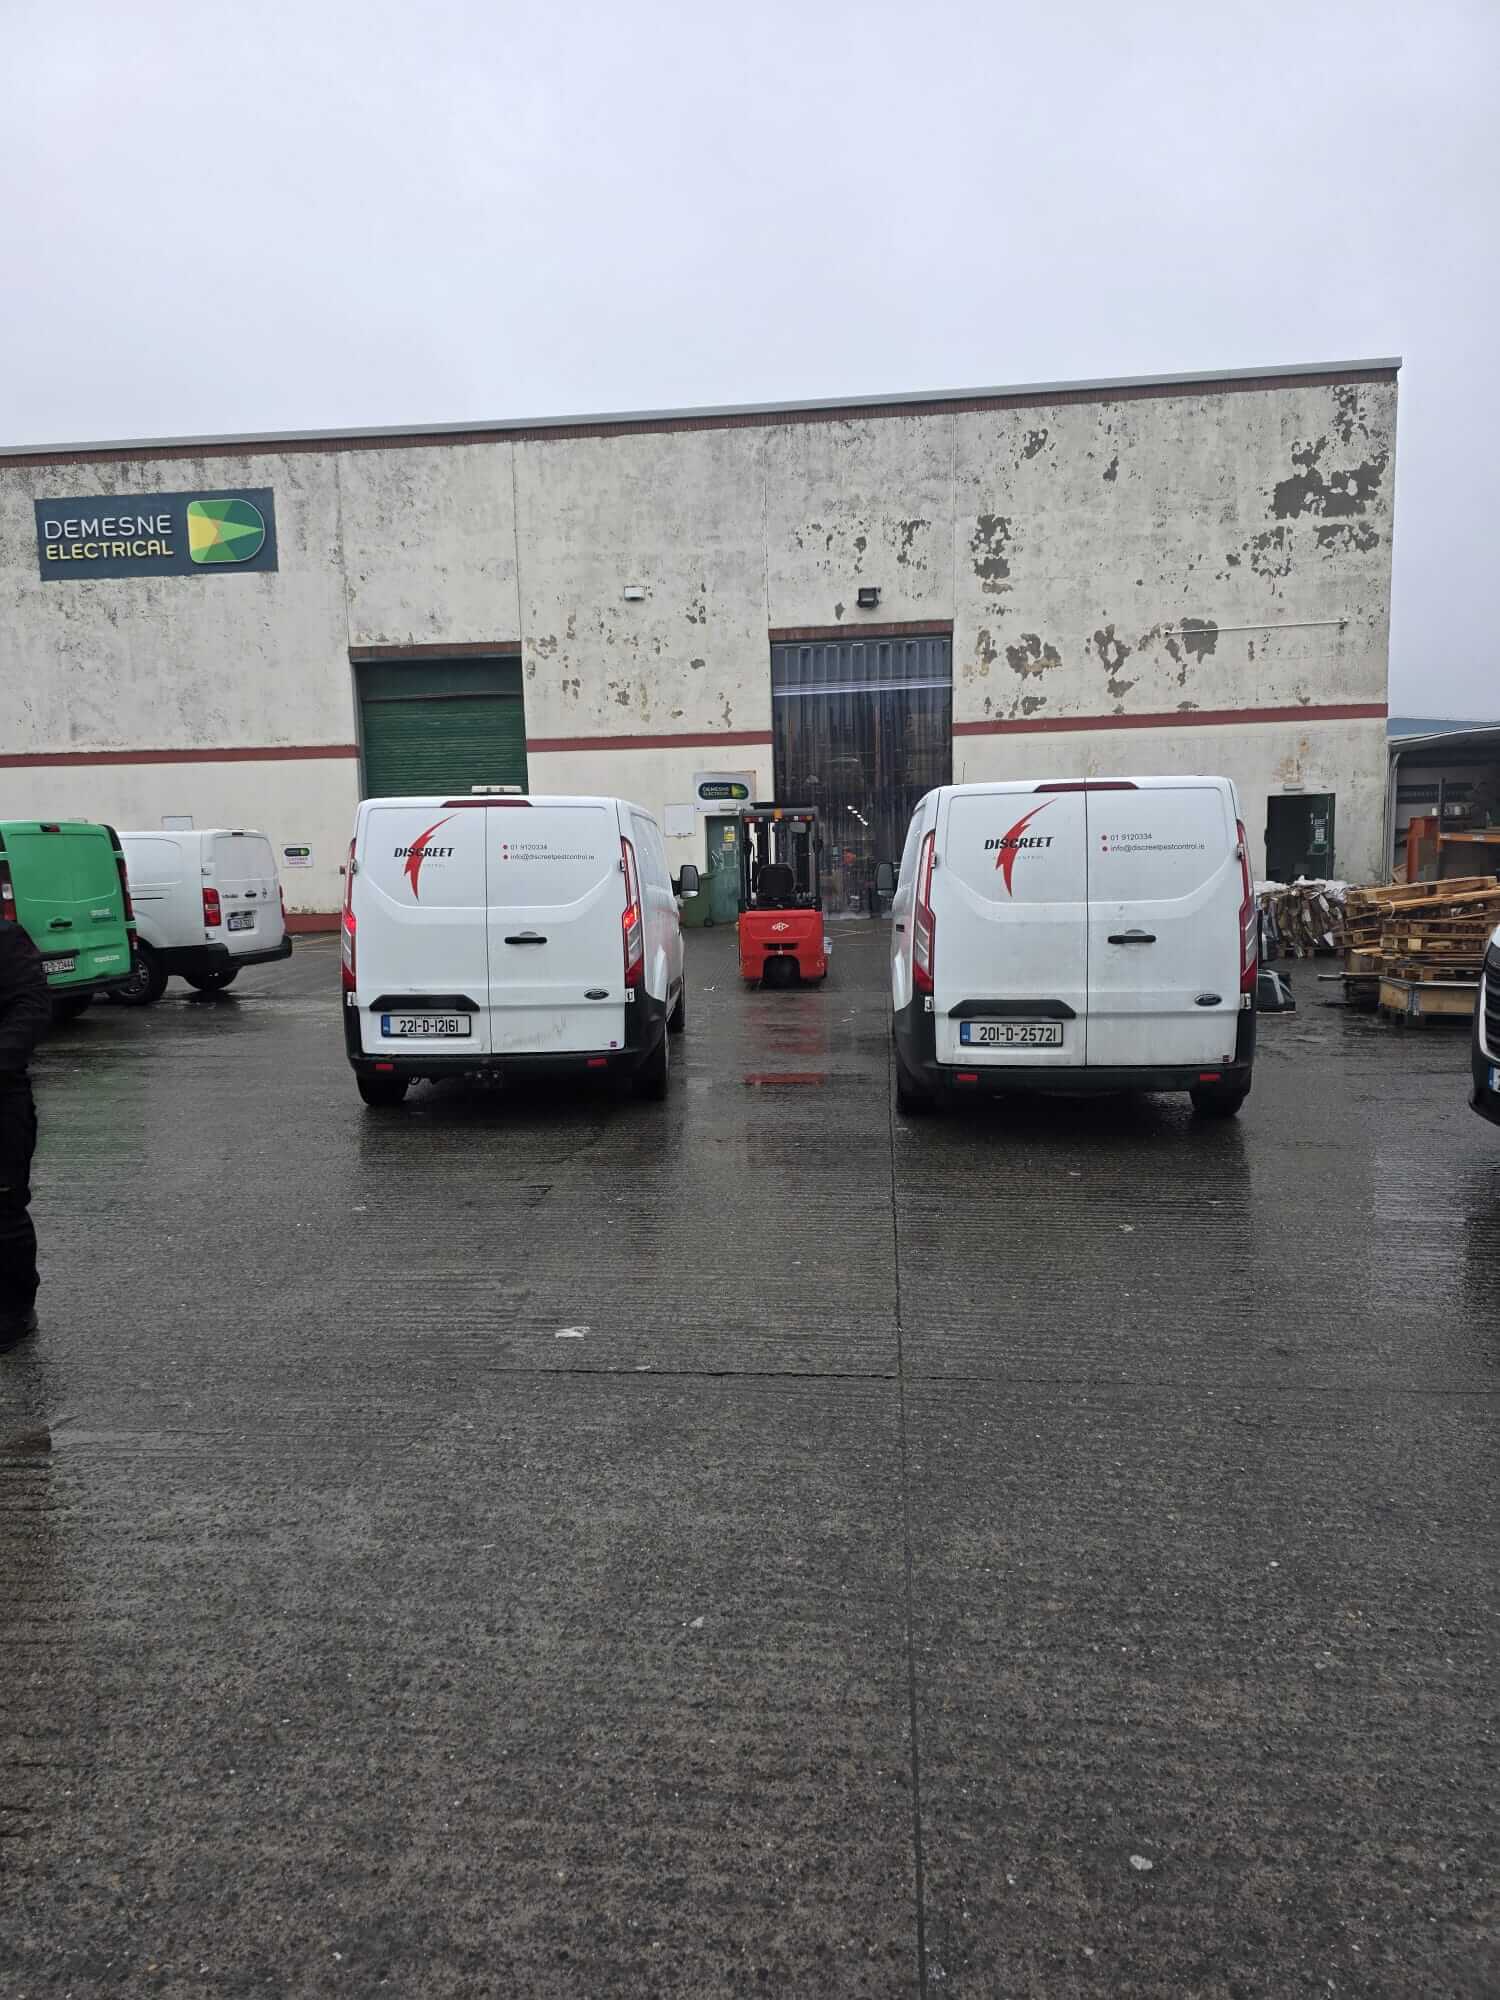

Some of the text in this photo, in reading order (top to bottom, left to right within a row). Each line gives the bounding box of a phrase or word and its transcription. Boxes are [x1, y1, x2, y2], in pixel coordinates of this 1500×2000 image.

[44, 514, 173, 539] DEMESNE
[46, 540, 174, 560] ELECTRICAL
[984, 836, 1055, 850] DISCREET
[392, 847, 456, 858] DISCREET
[400, 1019, 459, 1033] 221-D-12161
[979, 1026, 1056, 1042] 201-D-25721
